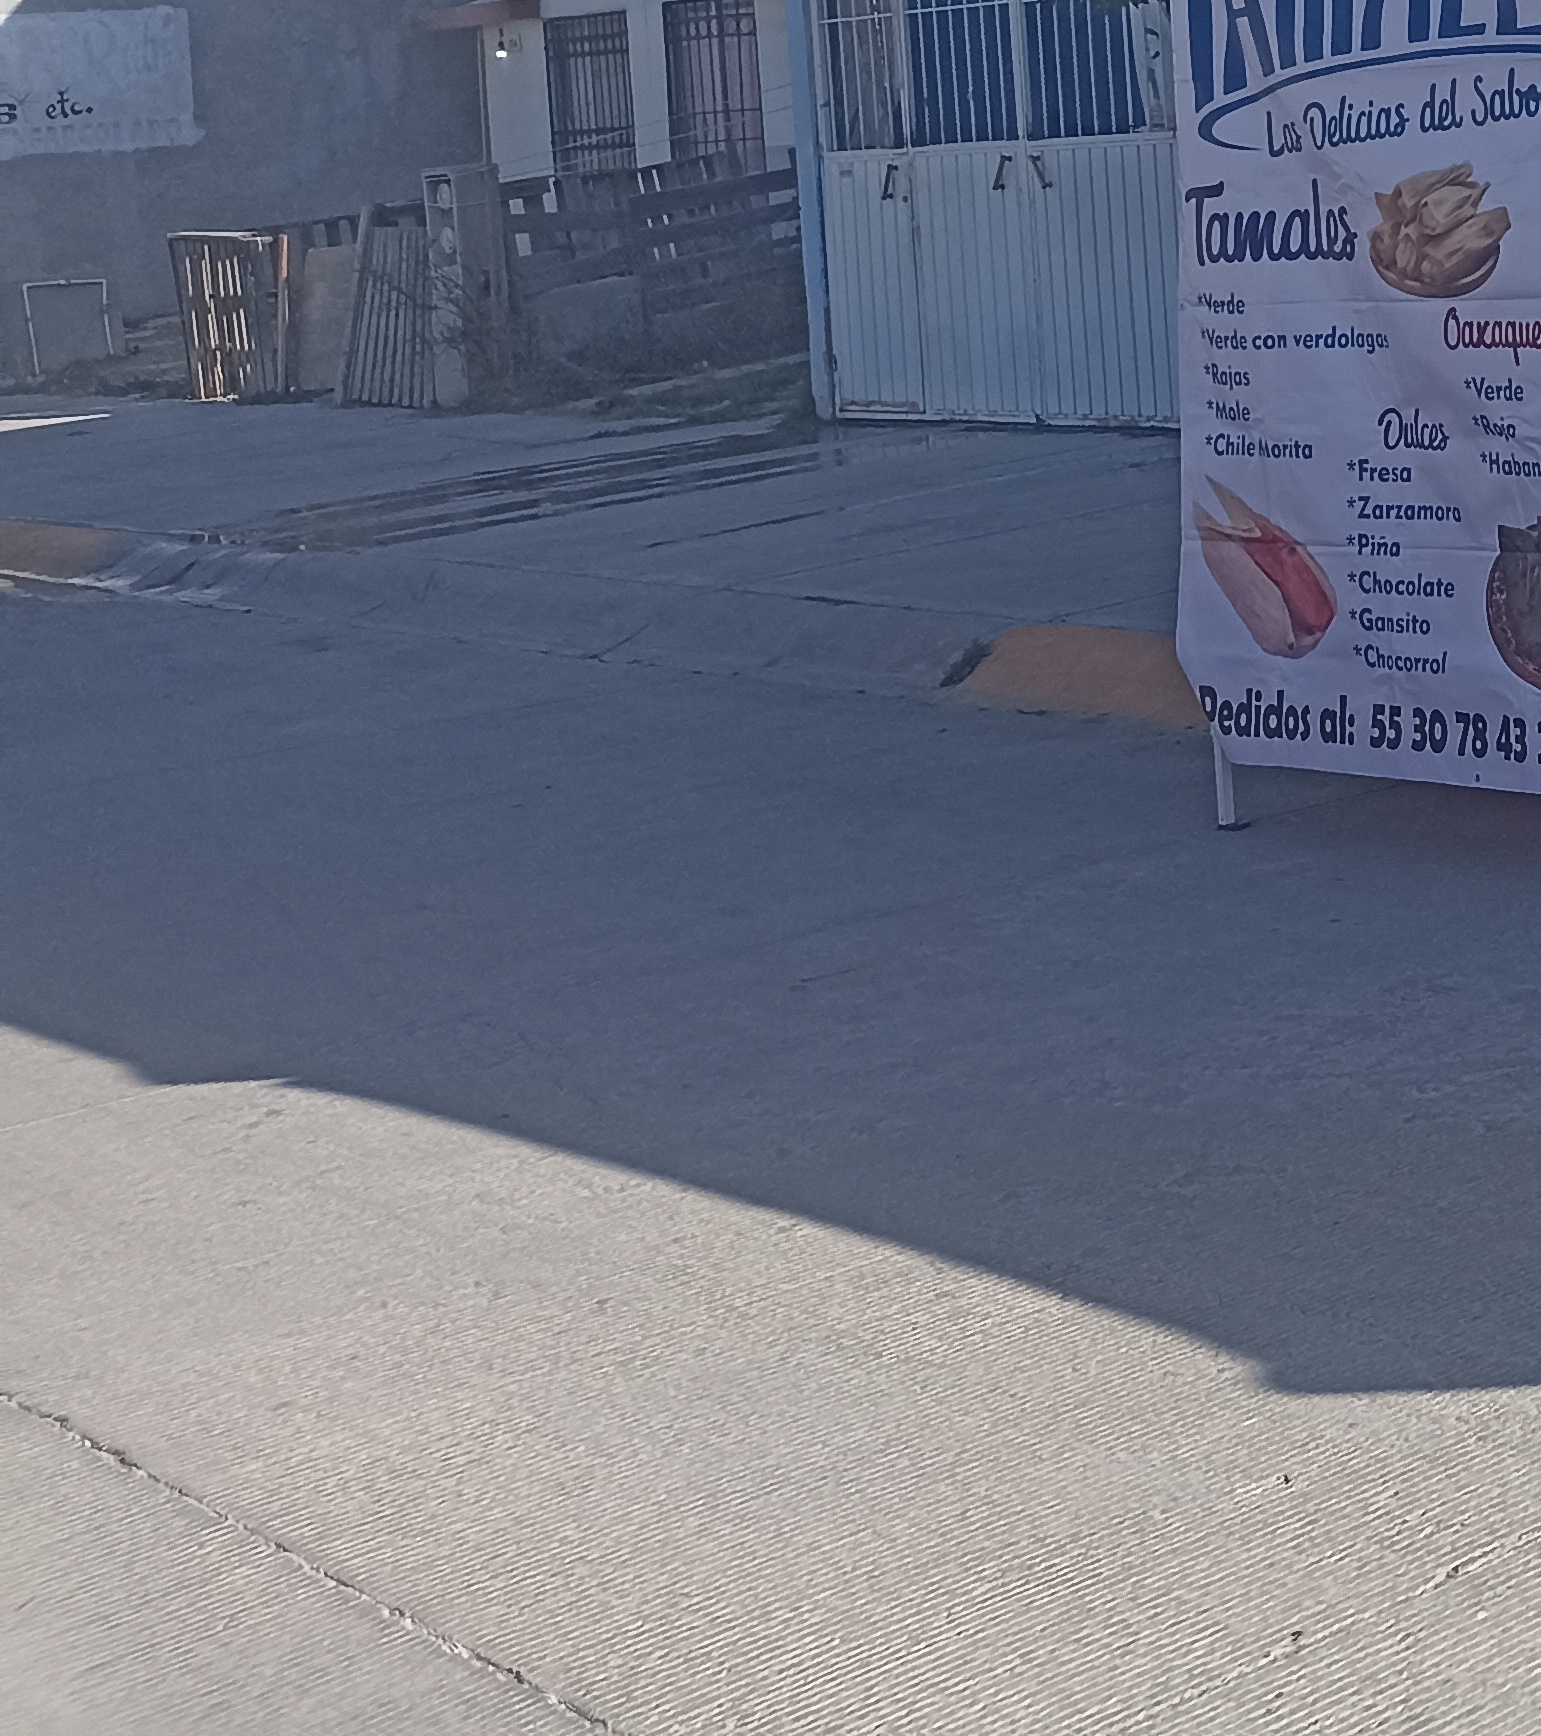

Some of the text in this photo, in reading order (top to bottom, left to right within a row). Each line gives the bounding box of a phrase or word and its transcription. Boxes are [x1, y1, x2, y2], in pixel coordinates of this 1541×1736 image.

[1267, 111, 1302, 157] Las
[1304, 96, 1410, 150] Delicias
[1420, 78, 1463, 131] del
[1185, 179, 1357, 266] Tamales
[1252, 335, 1287, 350] con
[1293, 325, 1389, 354] verdolagas
[1258, 437, 1312, 459] Morita
[1377, 407, 1449, 452] Dulces
[1199, 684, 1310, 741] Pedidos
[1320, 694, 1355, 744] al:
[1370, 704, 1401, 750] 55
[1411, 708, 1448, 752] 30
[1455, 711, 1488, 758] 78
[1496, 715, 1527, 763] 43
